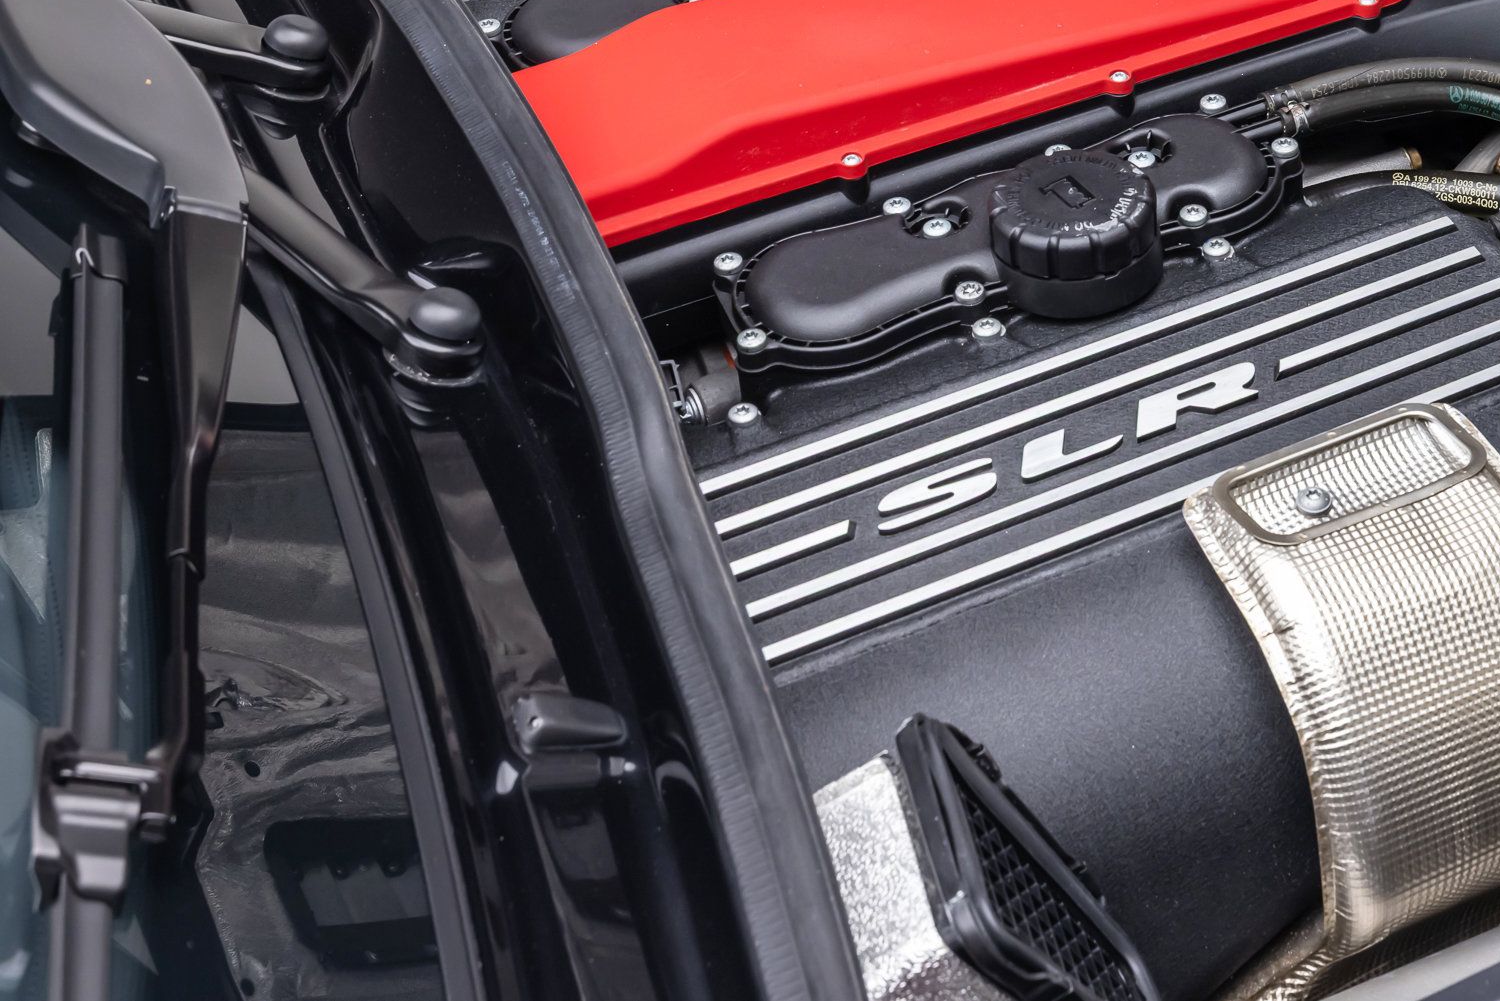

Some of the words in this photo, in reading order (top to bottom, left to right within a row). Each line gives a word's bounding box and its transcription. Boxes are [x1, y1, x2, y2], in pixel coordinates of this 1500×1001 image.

[1413, 175, 1429, 183] 199
[1432, 177, 1448, 185] 203
[1453, 179, 1474, 189] 1003
[1476, 182, 1498, 192] C-No
[877, 361, 1259, 536] SLR
